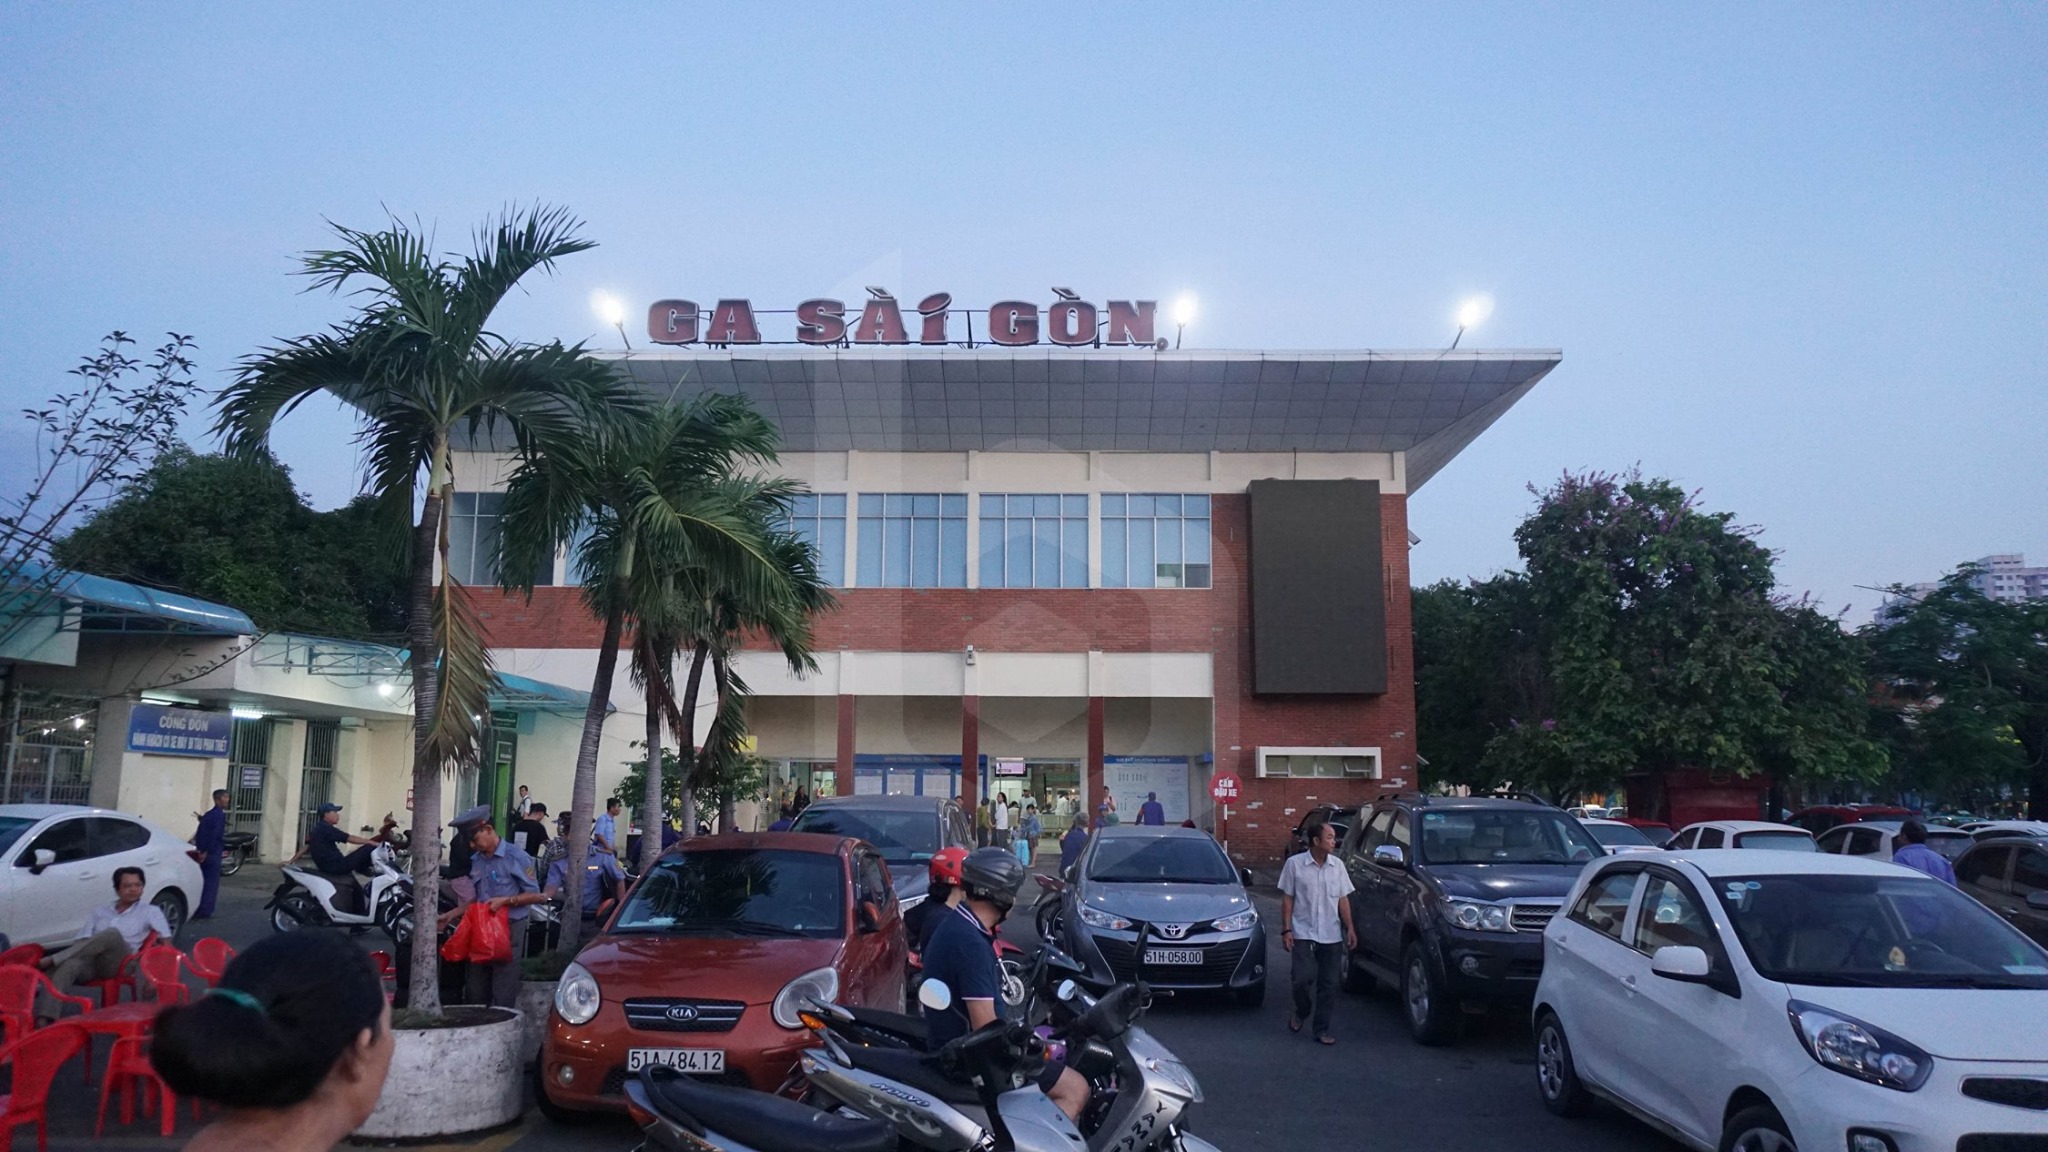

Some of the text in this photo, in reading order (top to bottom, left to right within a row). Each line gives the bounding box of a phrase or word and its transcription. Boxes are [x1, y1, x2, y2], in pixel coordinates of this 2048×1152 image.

[647, 298, 762, 346] GA
[988, 286, 1158, 346] GÒN
[1228, 788, 1238, 797] XE
[671, 1008, 693, 1018] KIA
